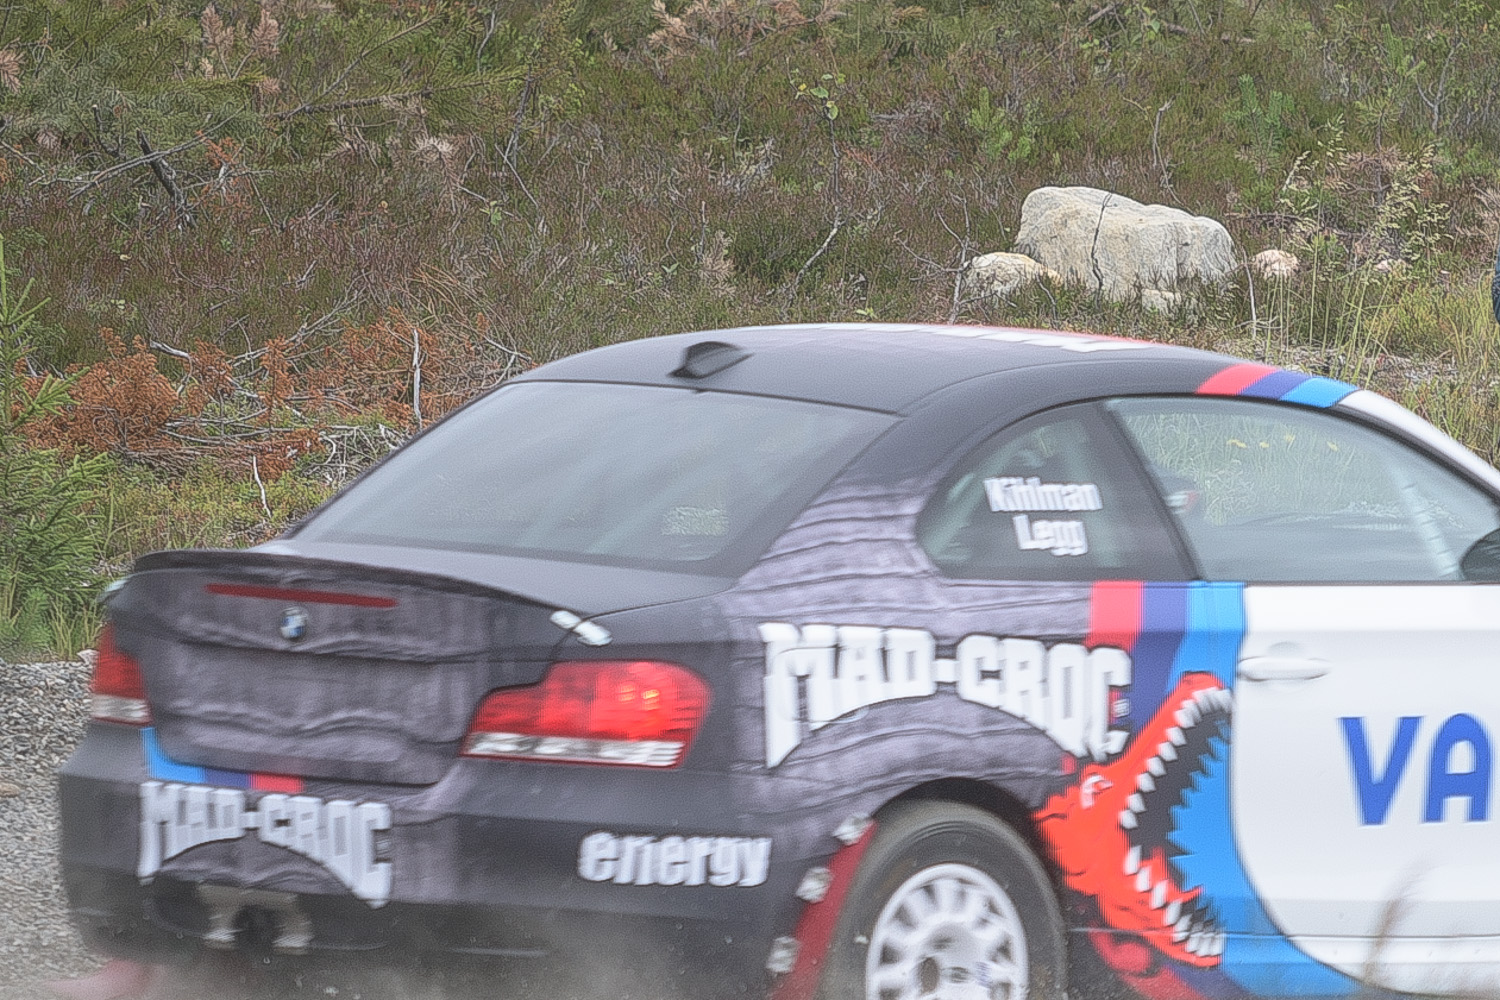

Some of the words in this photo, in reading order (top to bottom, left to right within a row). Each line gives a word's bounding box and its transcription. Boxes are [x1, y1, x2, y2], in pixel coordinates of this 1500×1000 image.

[759, 622, 1131, 768] MAD-CROC
[138, 781, 393, 908] MAD-CROC
[579, 832, 773, 887] energy
